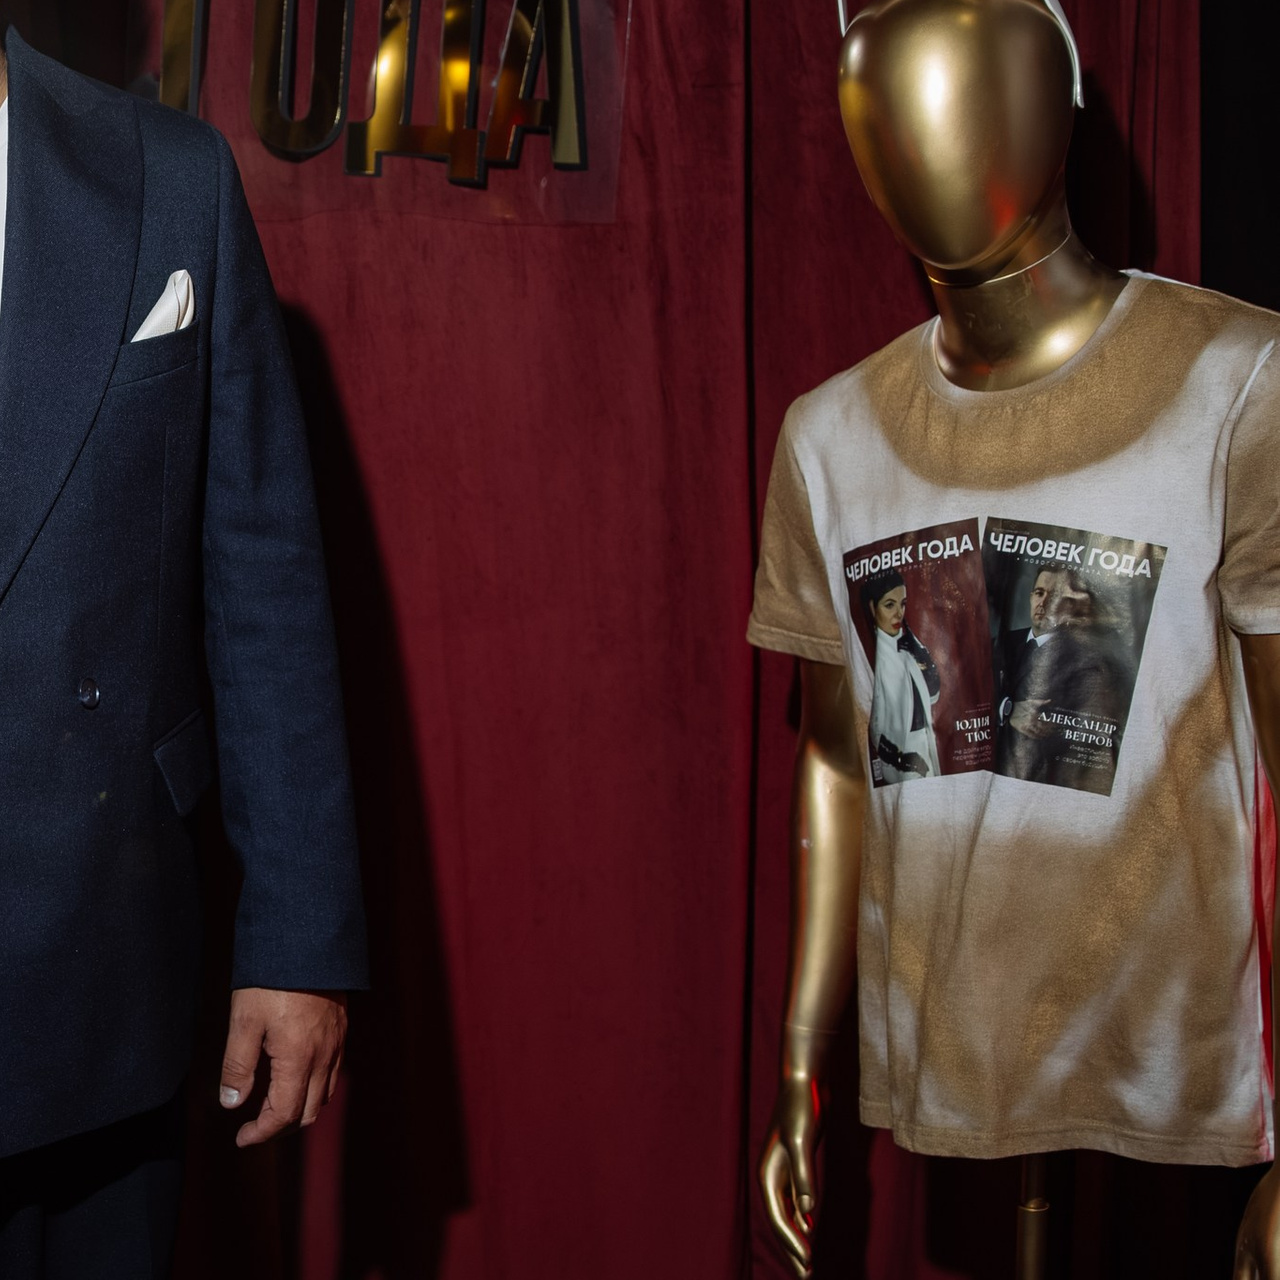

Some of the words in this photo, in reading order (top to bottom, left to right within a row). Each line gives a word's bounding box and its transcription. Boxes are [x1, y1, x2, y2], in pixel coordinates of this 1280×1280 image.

[845, 545, 913, 582] ЧЕЛОВЕК
[918, 534, 974, 561] ГОДА
[989, 532, 1085, 564] ЧЕЛОВЕК
[1087, 548, 1152, 578] ГОДА
[955, 715, 990, 731] ЮЛИЯ
[1038, 711, 1117, 734] АЛЕКСАНДР
[965, 729, 991, 743] ТЮС
[1064, 729, 1113, 748] ВЕТРОВ
